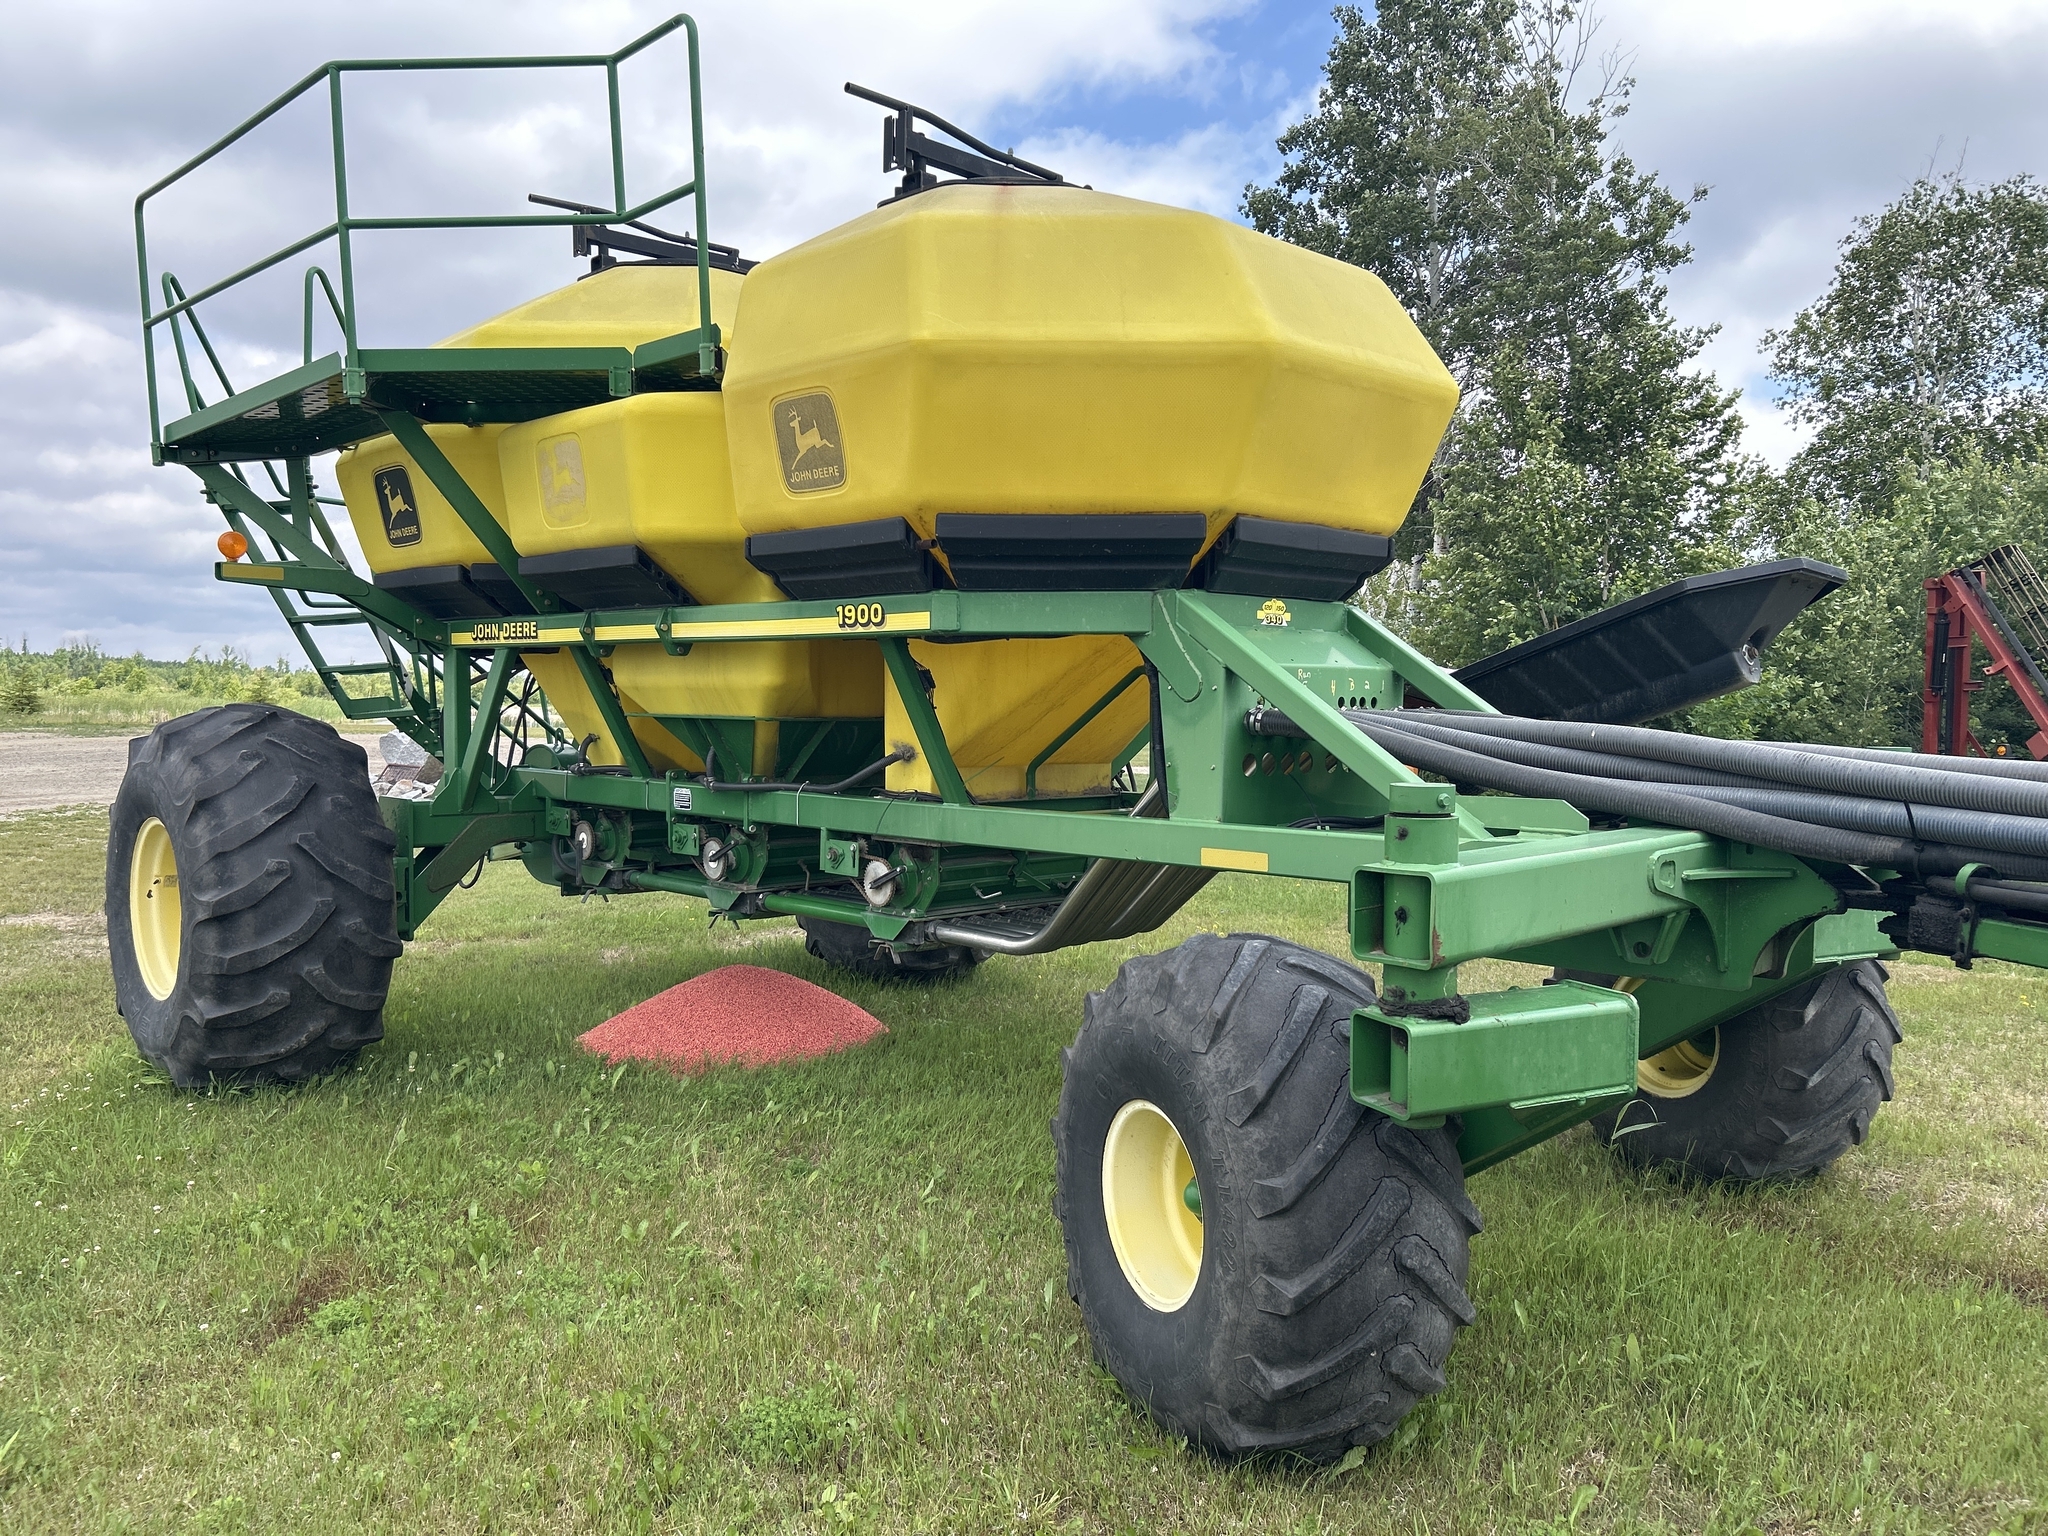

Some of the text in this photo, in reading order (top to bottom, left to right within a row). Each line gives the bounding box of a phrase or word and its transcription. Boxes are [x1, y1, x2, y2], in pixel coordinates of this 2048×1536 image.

[791, 465, 840, 482] JOHN DEERE
[390, 525, 418, 539] JOHN DEERE
[836, 602, 886, 629] 1900
[1265, 614, 1284, 625] 340
[471, 621, 539, 641] JOHN DEERE
[1151, 1032, 1211, 1123] TITAN
